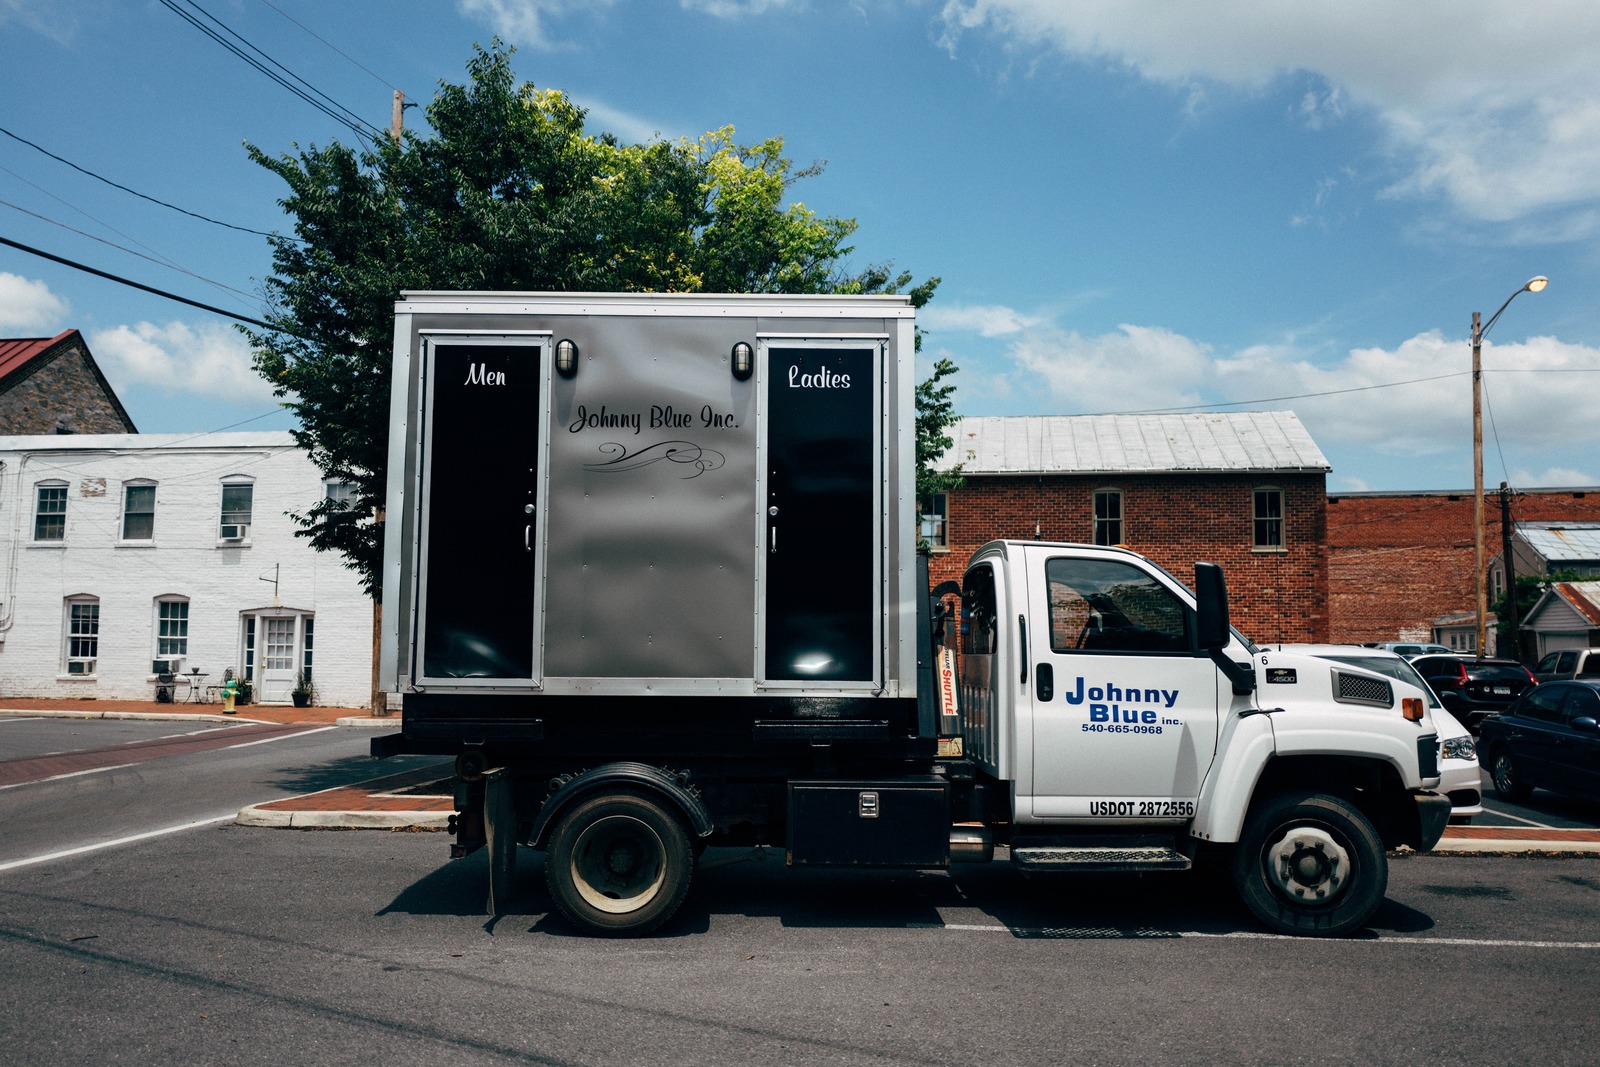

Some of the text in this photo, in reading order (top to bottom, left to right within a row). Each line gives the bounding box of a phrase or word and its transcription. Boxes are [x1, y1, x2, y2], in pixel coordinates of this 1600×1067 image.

[463, 362, 506, 386] Men
[788, 364, 851, 389] Ladies
[569, 404, 739, 435] Johnny Blue Inc.
[1261, 655, 1269, 666] 6
[943, 669, 954, 715] SHUTTLE
[1065, 676, 1180, 709] Johnny
[1089, 703, 1184, 726] Blue inc.
[1081, 723, 1163, 735] 540-665-0968
[1090, 801, 1194, 816] USDOT 2872556
